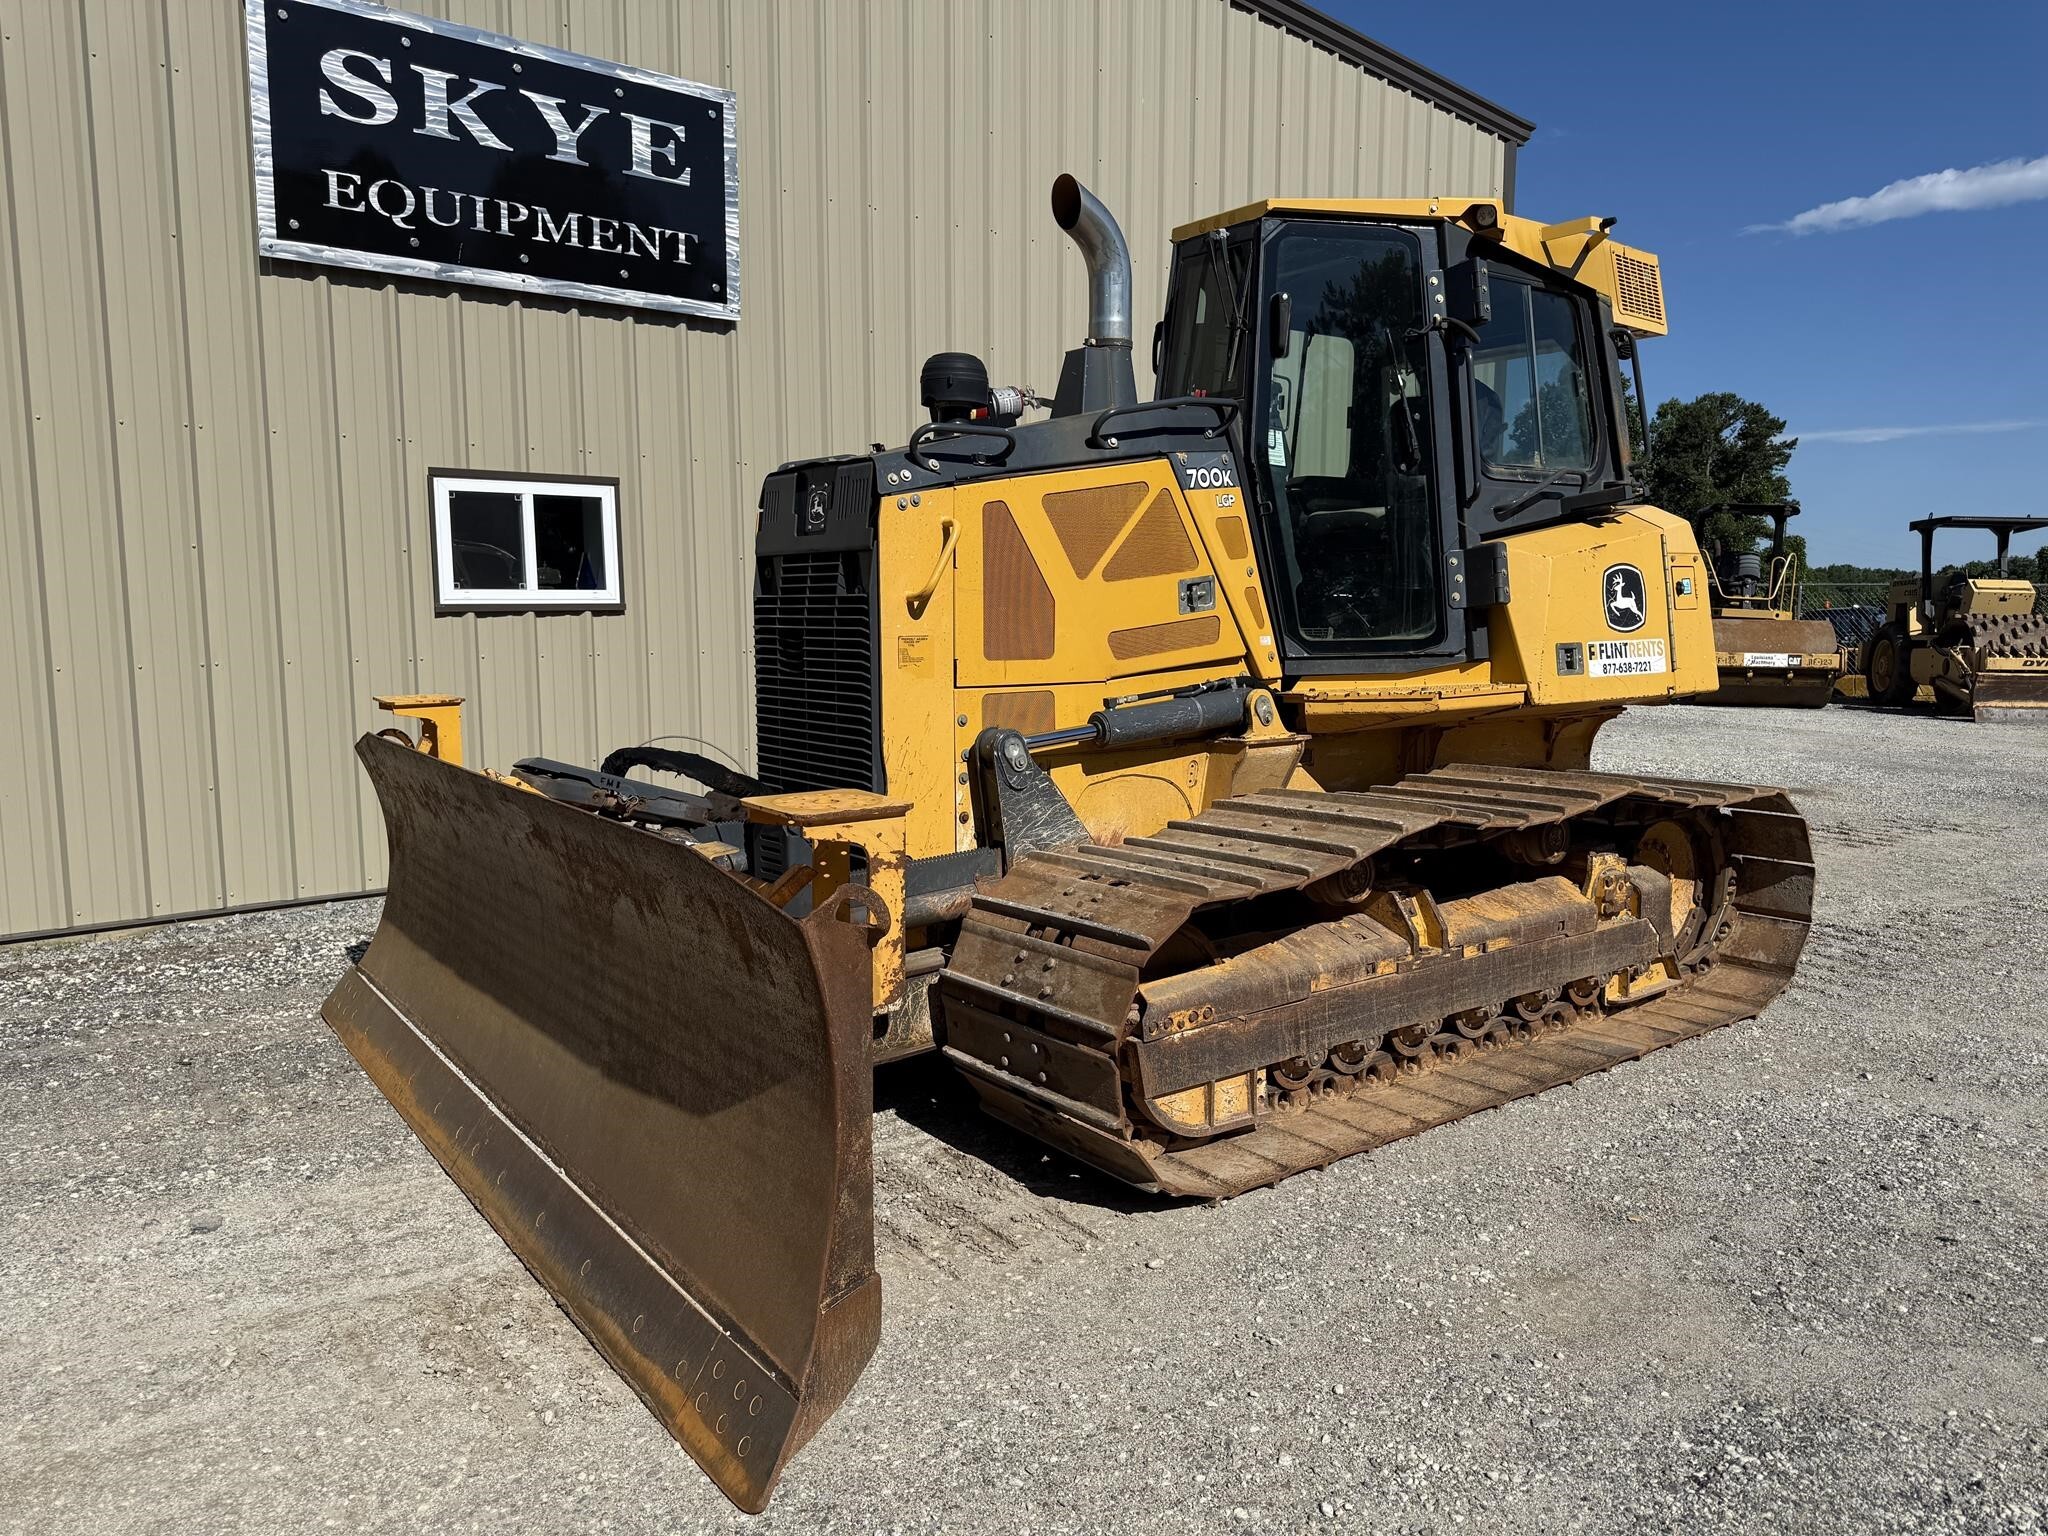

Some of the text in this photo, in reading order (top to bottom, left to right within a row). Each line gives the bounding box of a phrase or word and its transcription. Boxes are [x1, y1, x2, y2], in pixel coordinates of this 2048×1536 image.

[319, 47, 692, 187] SKYE
[320, 168, 699, 265] EQUIPMENT
[1185, 468, 1235, 489] 700K
[1215, 494, 1236, 508] LGP
[1602, 661, 1652, 675] 877-638-7221
[2022, 659, 2048, 667] DY
